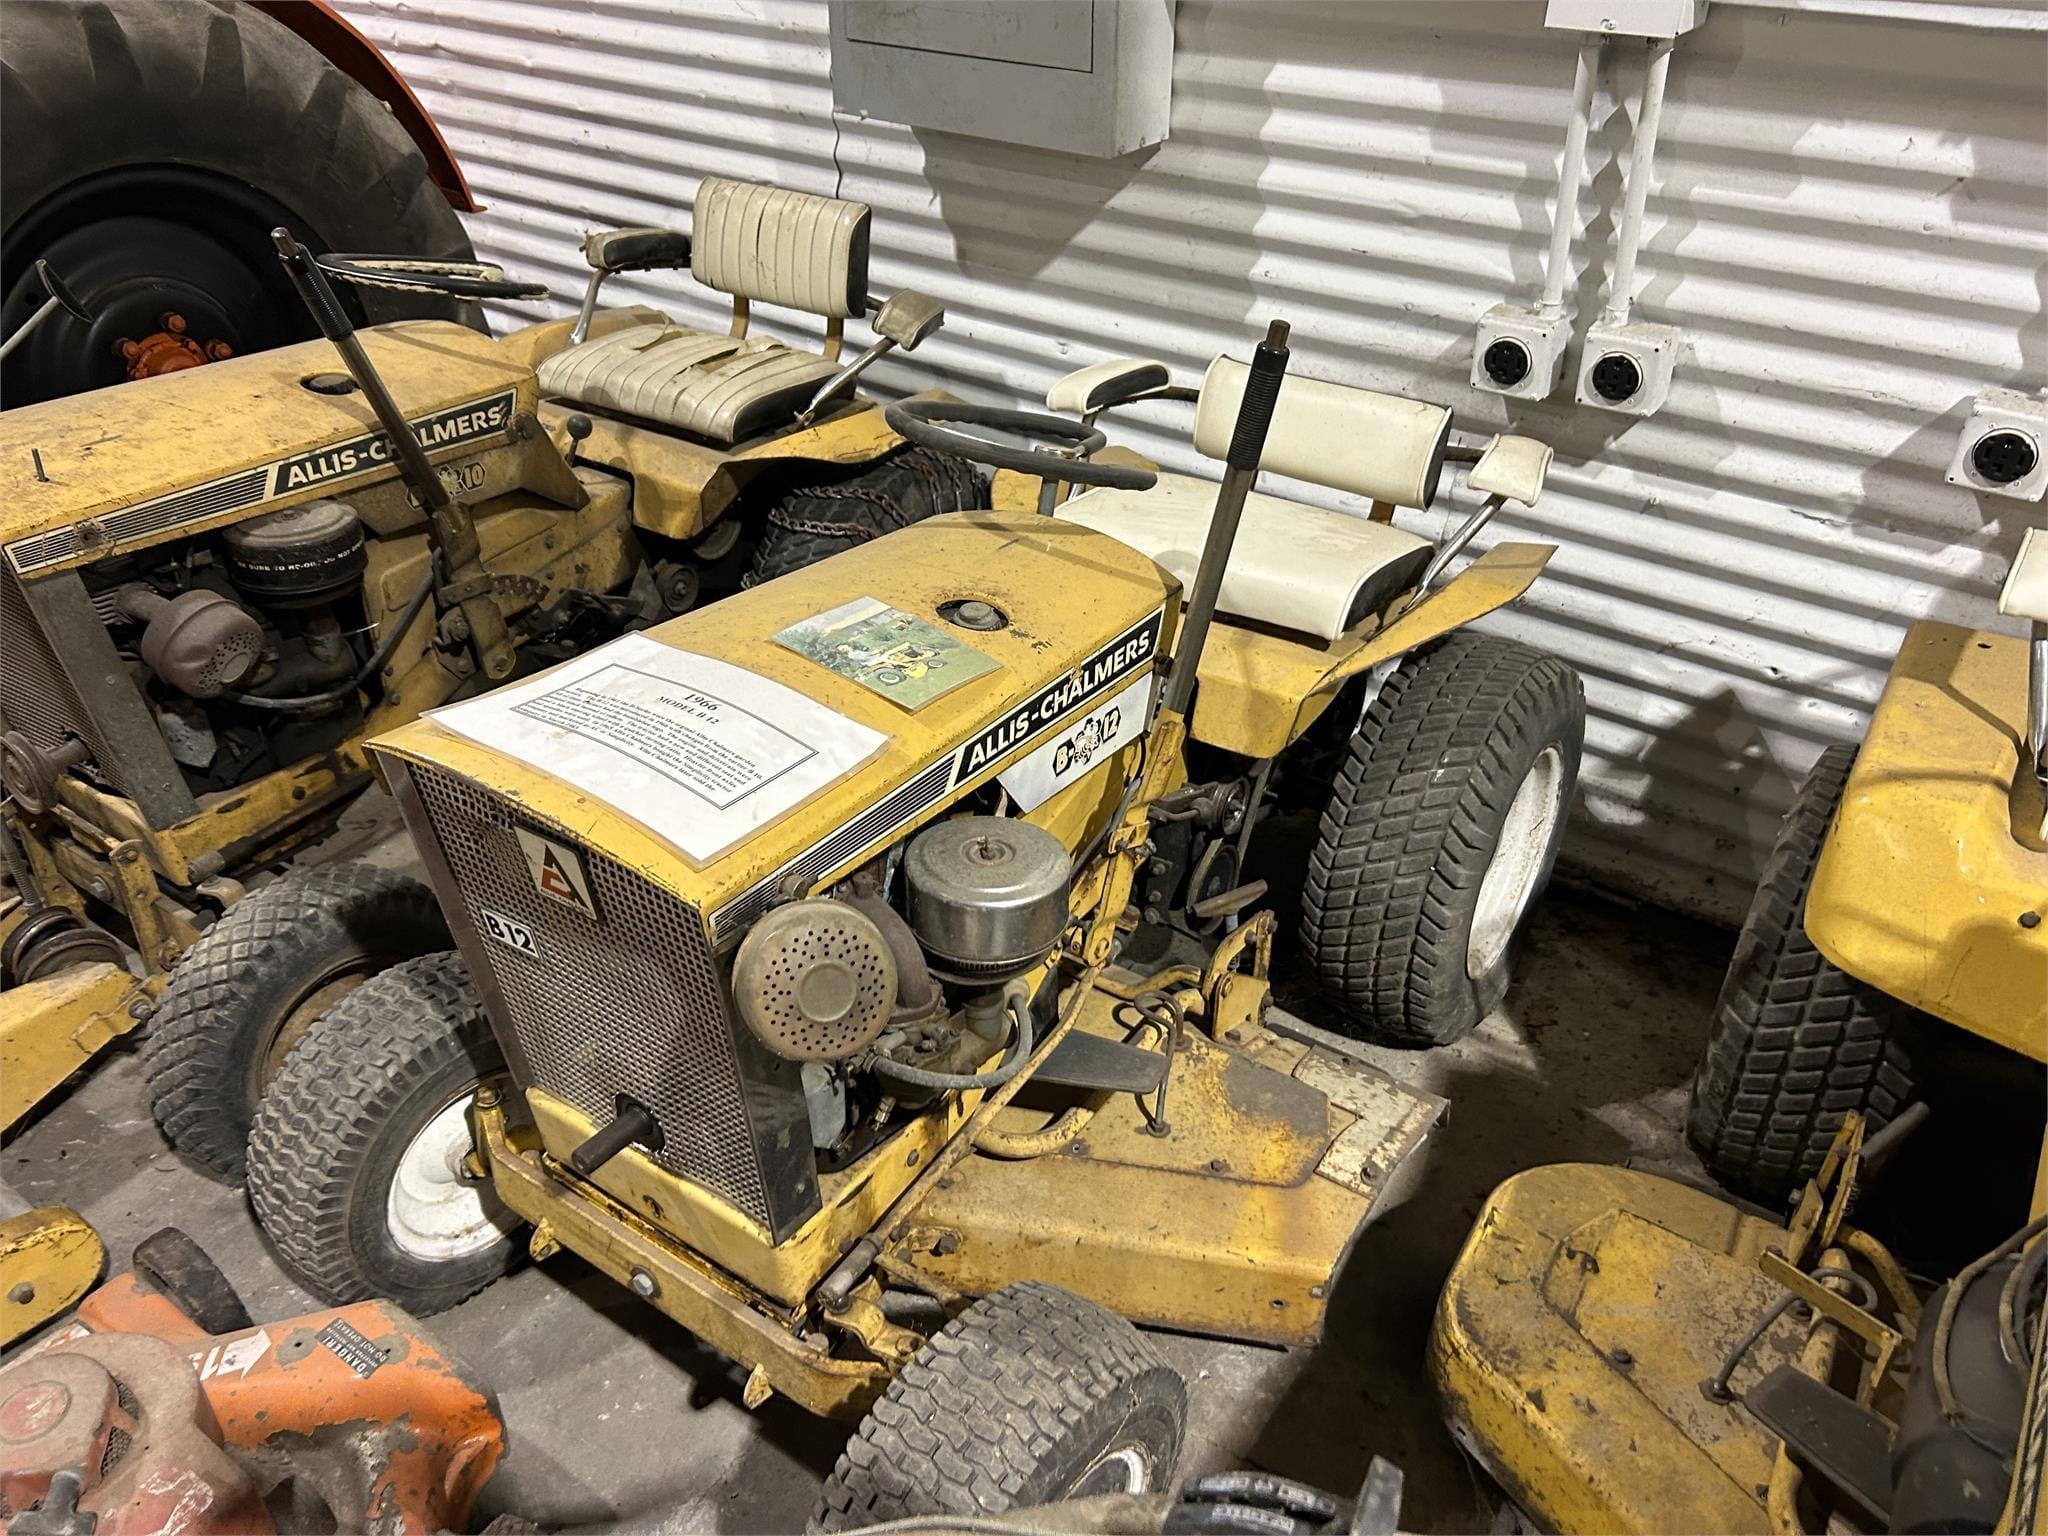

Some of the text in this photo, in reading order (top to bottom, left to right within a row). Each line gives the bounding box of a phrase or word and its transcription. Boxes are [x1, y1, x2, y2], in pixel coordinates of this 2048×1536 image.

[656, 696, 695, 714] MODEL
[684, 693, 722, 711] 1966
[965, 629, 1152, 773] ALLIS-CHALMERS
[678, 739, 697, 749] engine
[737, 771, 752, 781] were
[681, 733, 704, 745] changes
[704, 744, 718, 753] from
[728, 759, 748, 770] earlier
[708, 739, 735, 755] Chalmers
[734, 755, 756, 767] garden
[651, 753, 679, 769] Chalmers
[678, 767, 693, 777] later
[693, 776, 707, 785] sold
[705, 783, 716, 791] the
[684, 762, 711, 780] Simplicity
[711, 779, 733, 793] tractor
[696, 755, 722, 770] different
[721, 769, 734, 778] seat
[733, 777, 747, 785] and
[706, 768, 722, 779] front
[721, 778, 737, 788] axles
[334, 1319, 361, 1342] OPERATE
